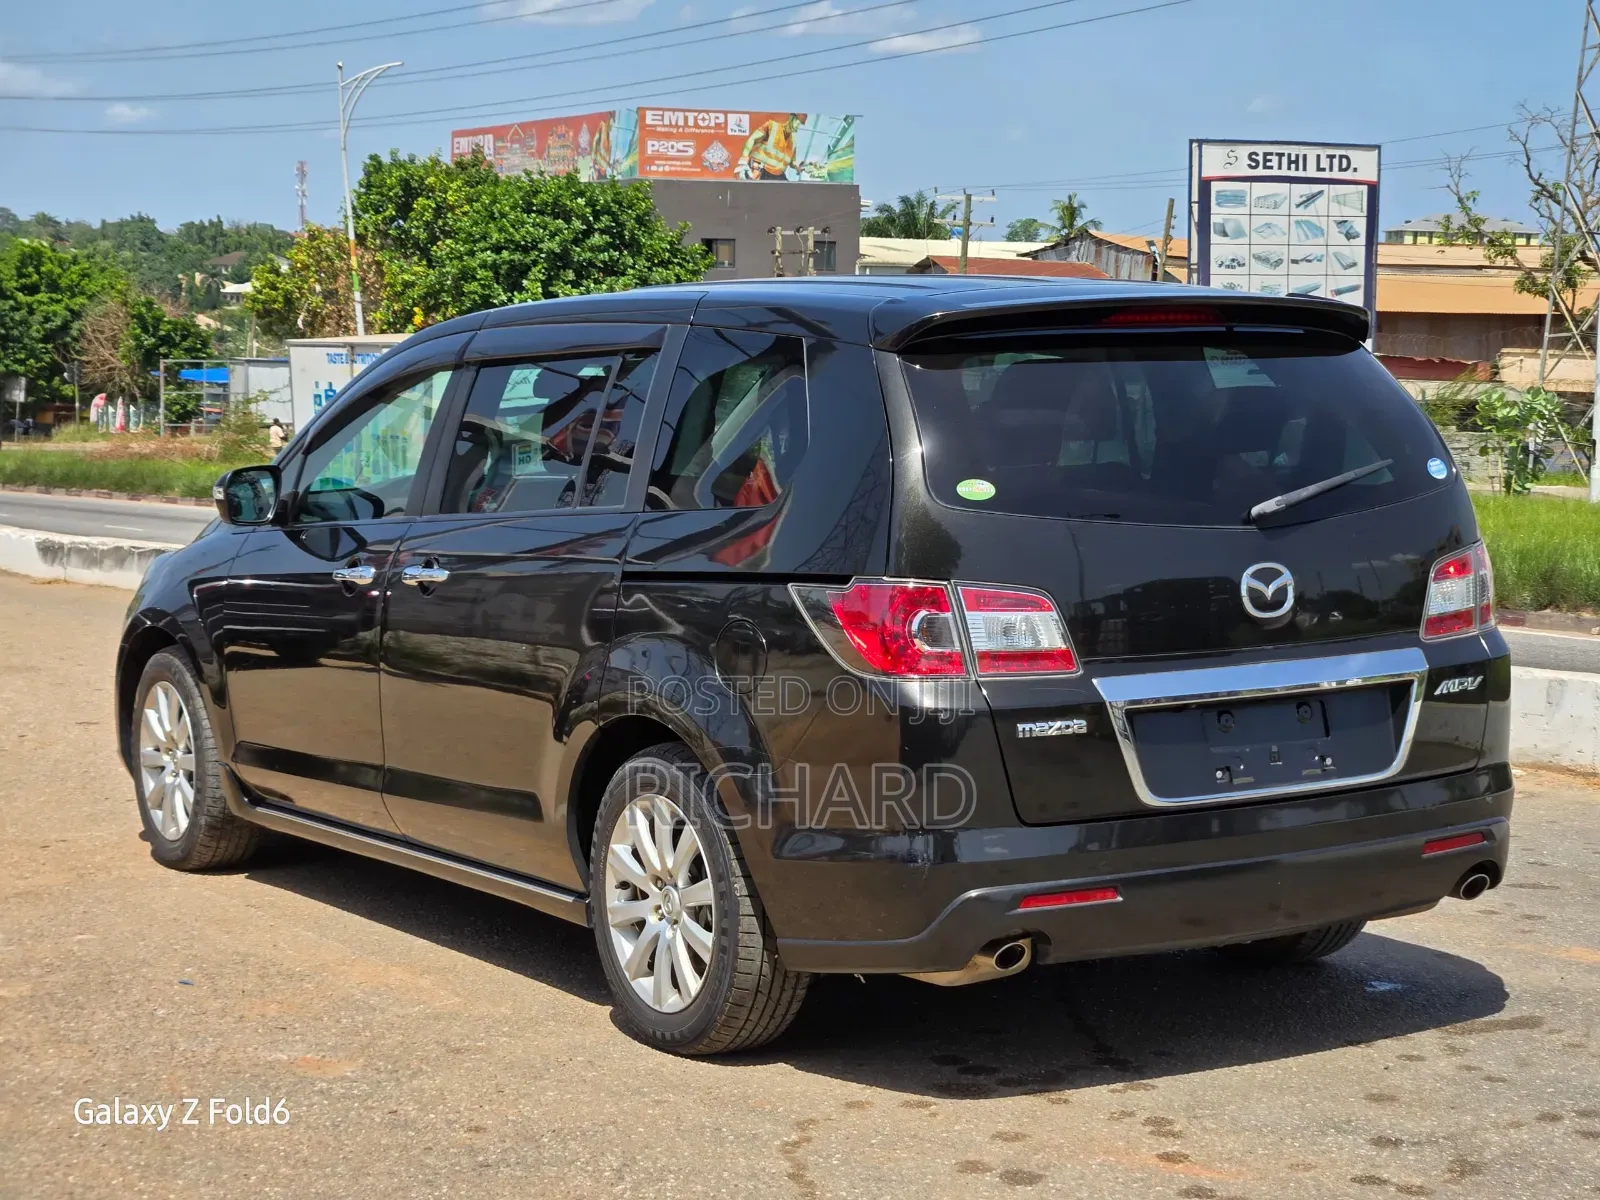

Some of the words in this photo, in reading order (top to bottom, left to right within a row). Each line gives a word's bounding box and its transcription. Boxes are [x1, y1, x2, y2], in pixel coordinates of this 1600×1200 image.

[645, 110, 725, 126] EMTOP
[647, 140, 694, 156] P20S
[1247, 151, 1307, 172] SETHI
[1316, 153, 1358, 173] LTD.
